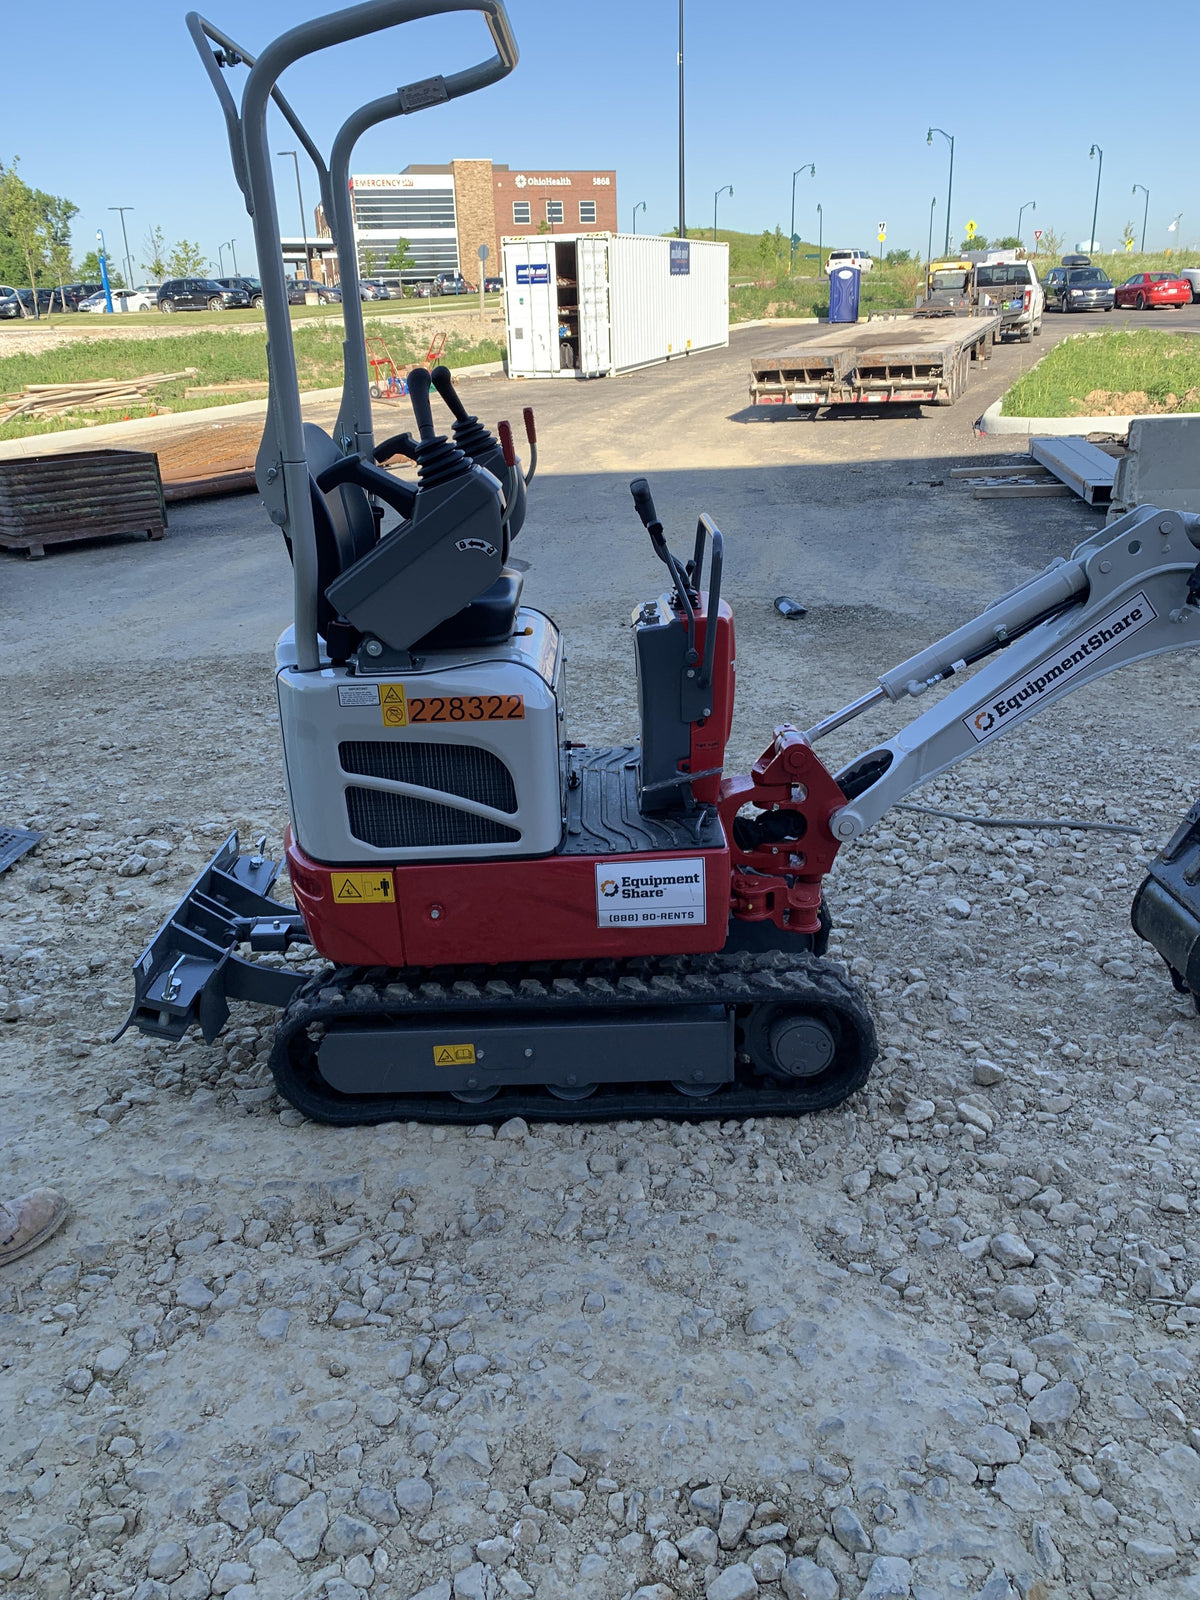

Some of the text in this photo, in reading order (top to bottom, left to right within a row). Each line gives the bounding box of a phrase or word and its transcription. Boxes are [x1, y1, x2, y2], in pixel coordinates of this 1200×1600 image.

[355, 179, 401, 187] EMERGENCY
[528, 177, 572, 186] OhioHealth
[592, 177, 610, 186] 5868
[410, 695, 523, 722] 228322
[621, 873, 700, 889] Equipment
[609, 913, 639, 923] (888)
